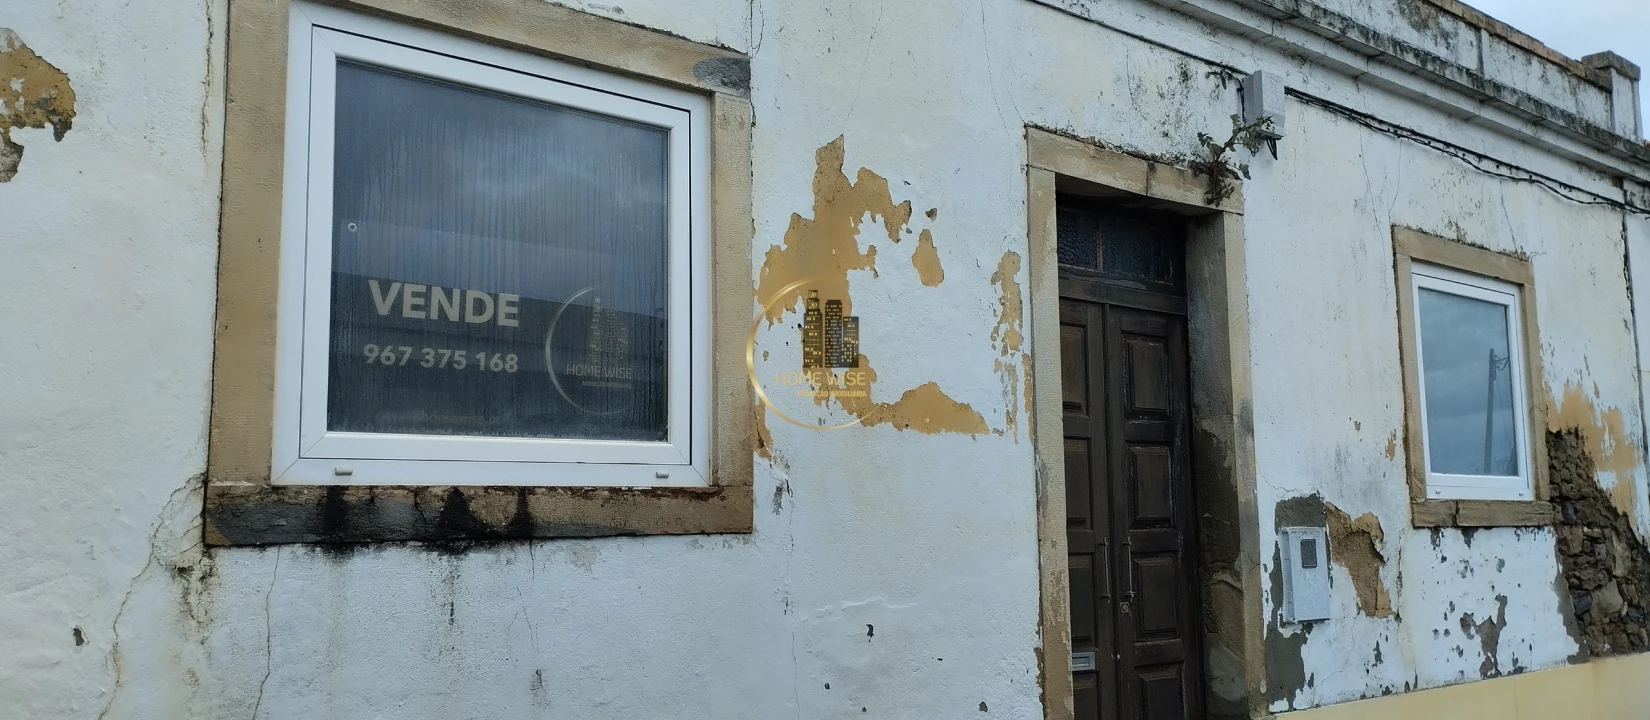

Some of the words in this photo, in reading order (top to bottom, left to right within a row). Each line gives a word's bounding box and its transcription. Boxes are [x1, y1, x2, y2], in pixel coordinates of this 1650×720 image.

[368, 279, 520, 327] VENDE
[363, 343, 412, 366] 967
[420, 347, 467, 370] 375
[475, 351, 519, 373] 168
[566, 363, 601, 377] HOME
[604, 366, 633, 379] WISE
